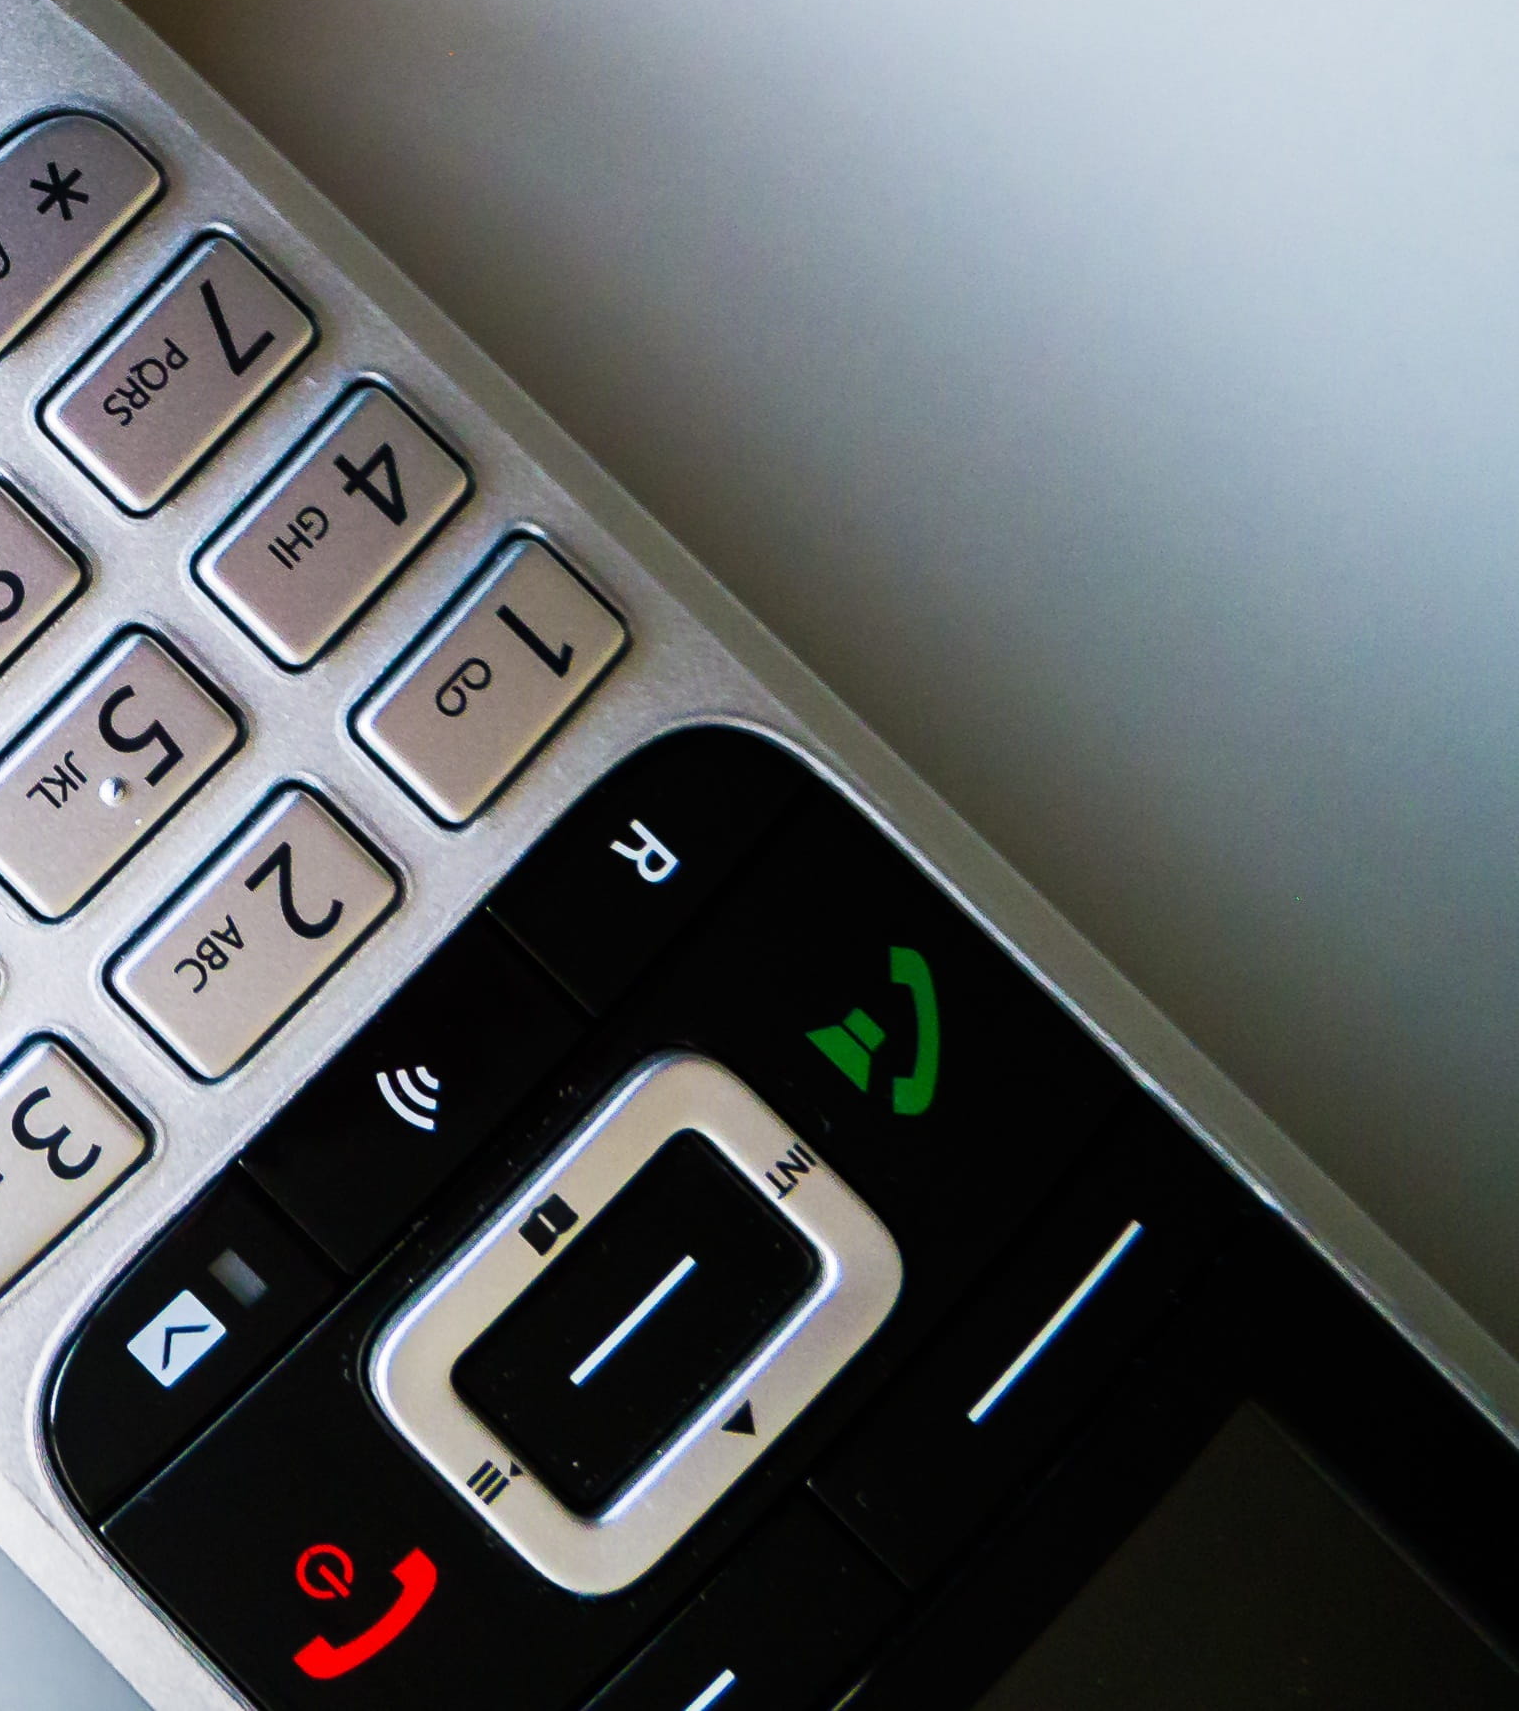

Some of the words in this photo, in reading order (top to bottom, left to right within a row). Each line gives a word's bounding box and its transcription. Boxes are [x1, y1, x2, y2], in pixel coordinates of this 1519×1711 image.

[200, 280, 275, 376] 7
[104, 338, 188, 426] PQRS
[334, 443, 407, 526] 4
[268, 507, 328, 569] GHI
[496, 605, 573, 677] 1
[99, 685, 183, 787] 5
[27, 751, 87, 808] JKL
[245, 842, 343, 939] 2
[611, 820, 678, 882] R
[175, 915, 244, 993] ABC
[12, 1087, 101, 1179] 3
[766, 1143, 816, 1198] INT
